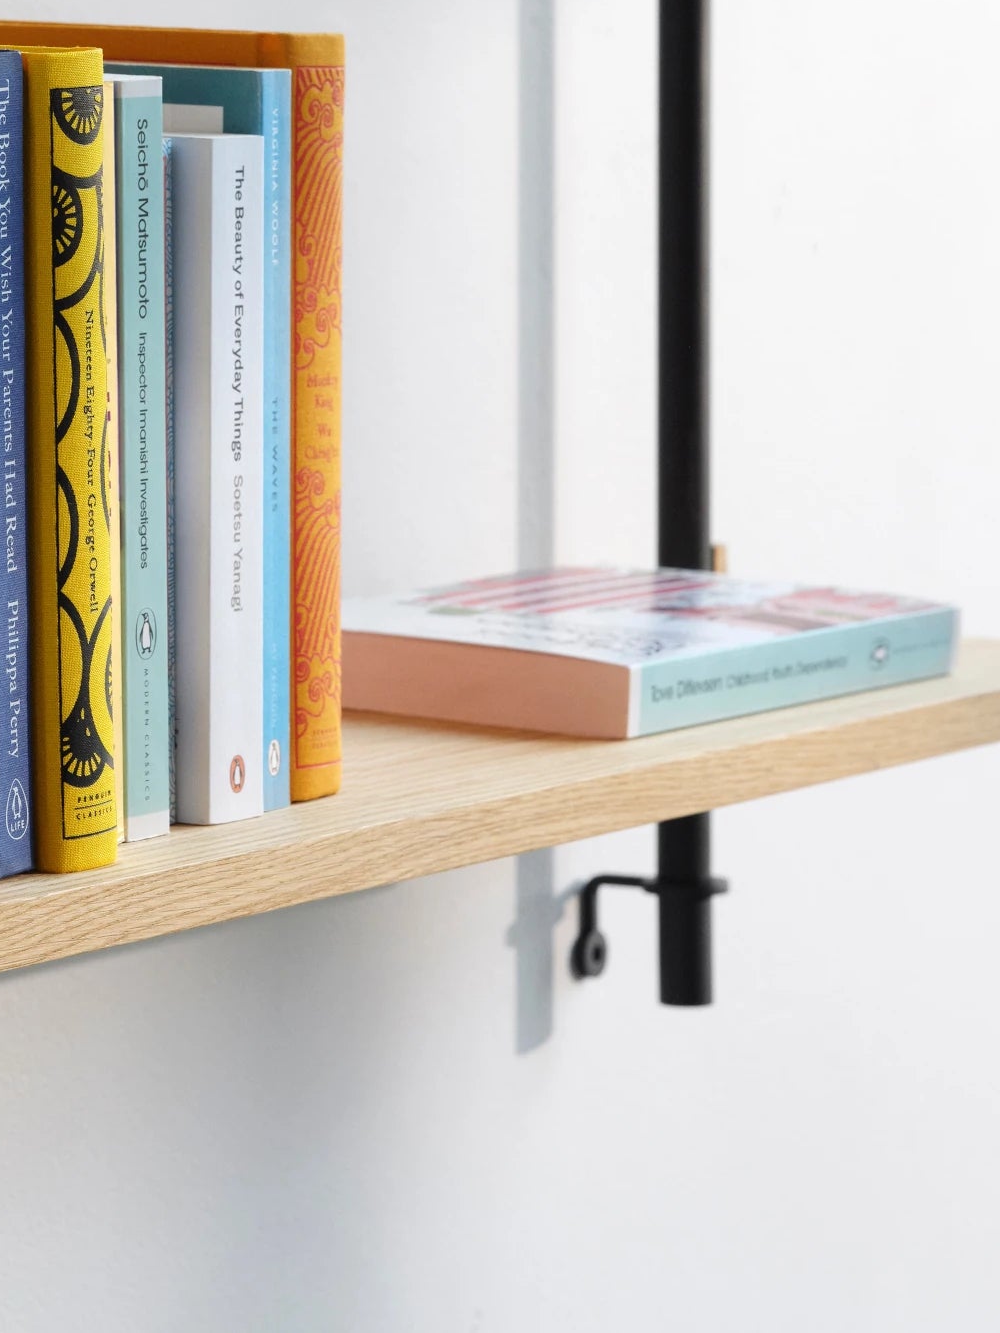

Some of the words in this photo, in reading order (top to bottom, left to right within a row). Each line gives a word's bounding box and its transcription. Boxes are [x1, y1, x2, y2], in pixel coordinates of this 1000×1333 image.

[271, 107, 279, 193] VIRGINIA
[234, 165, 245, 202] The
[137, 199, 149, 320] Matsumoto
[233, 206, 245, 276] Beauty
[271, 200, 280, 267] WOOLF
[0, 244, 11, 303] Wish
[234, 277, 244, 300] of
[0, 309, 12, 363] Your
[85, 309, 94, 381] Nineteen
[136, 331, 147, 406] Inspector
[231, 303, 244, 395] Everyday
[1, 368, 14, 452] Parents
[138, 407, 147, 475] Imanishi
[231, 396, 244, 462] Things
[271, 396, 279, 434] THE
[4, 459, 16, 504] Had
[232, 474, 244, 544] Soetsu
[271, 444, 279, 514] WAVES
[6, 516, 18, 573] Read
[85, 495, 97, 555] George
[138, 477, 149, 570] Investigates
[89, 556, 99, 614] Orwell
[230, 545, 244, 613] Yanagi
[4, 599, 19, 694] Philippa
[8, 699, 22, 759] Perry
[10, 819, 26, 832] LIFE
[75, 805, 113, 821] CLASSICS
[77, 789, 112, 804] PENGUIN
